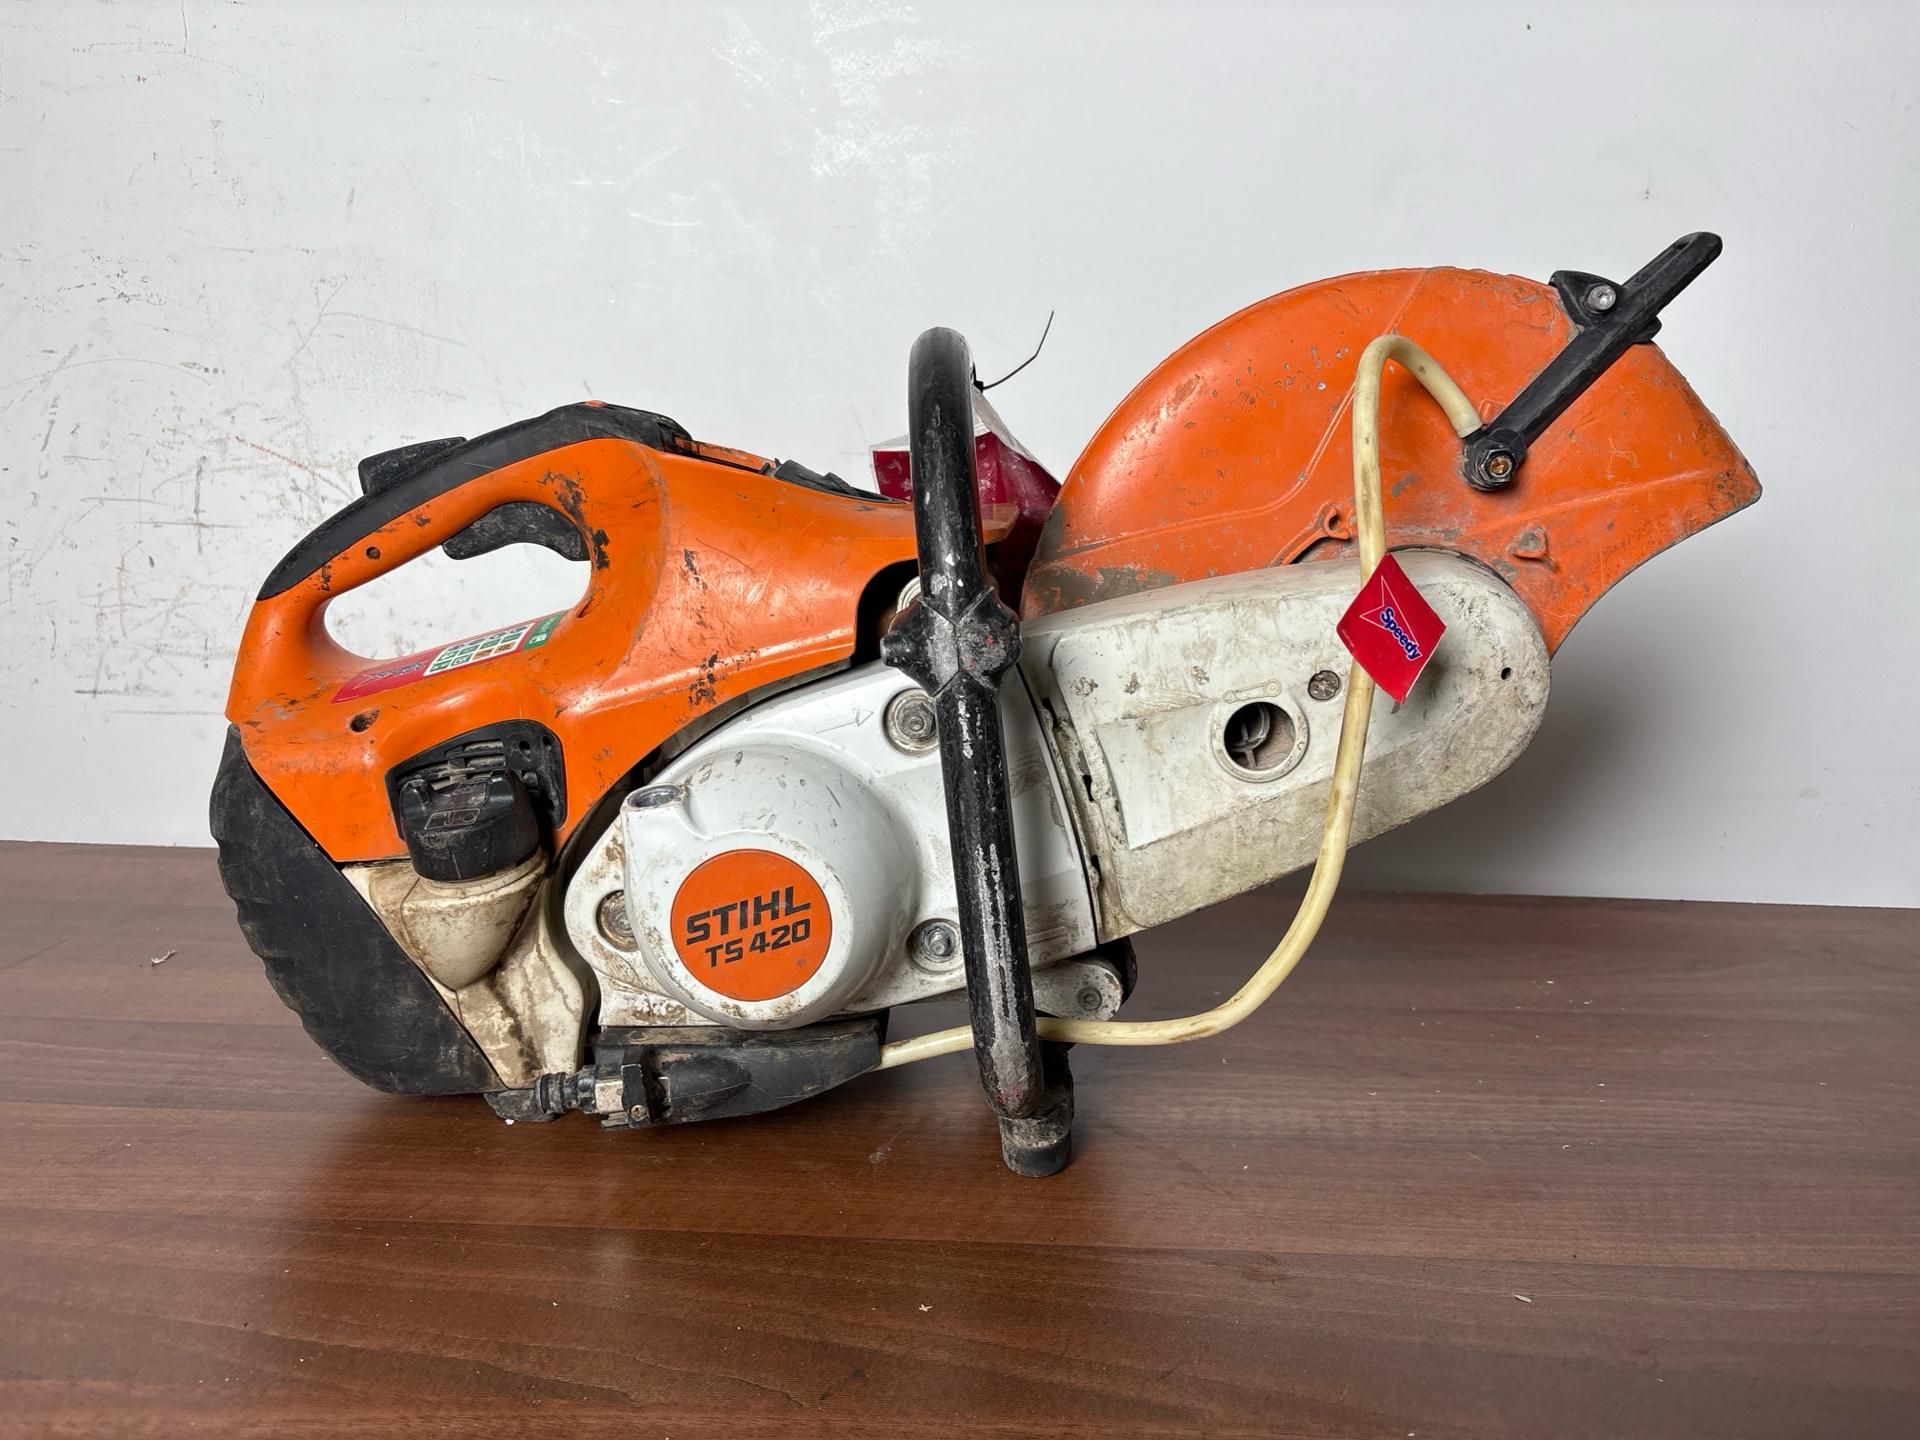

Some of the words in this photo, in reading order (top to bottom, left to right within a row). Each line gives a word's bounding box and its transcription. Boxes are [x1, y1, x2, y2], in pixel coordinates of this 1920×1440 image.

[1380, 606, 1422, 661] Speedy
[686, 886, 811, 945] STIHL
[704, 938, 743, 968] TS
[750, 918, 811, 953] 420
